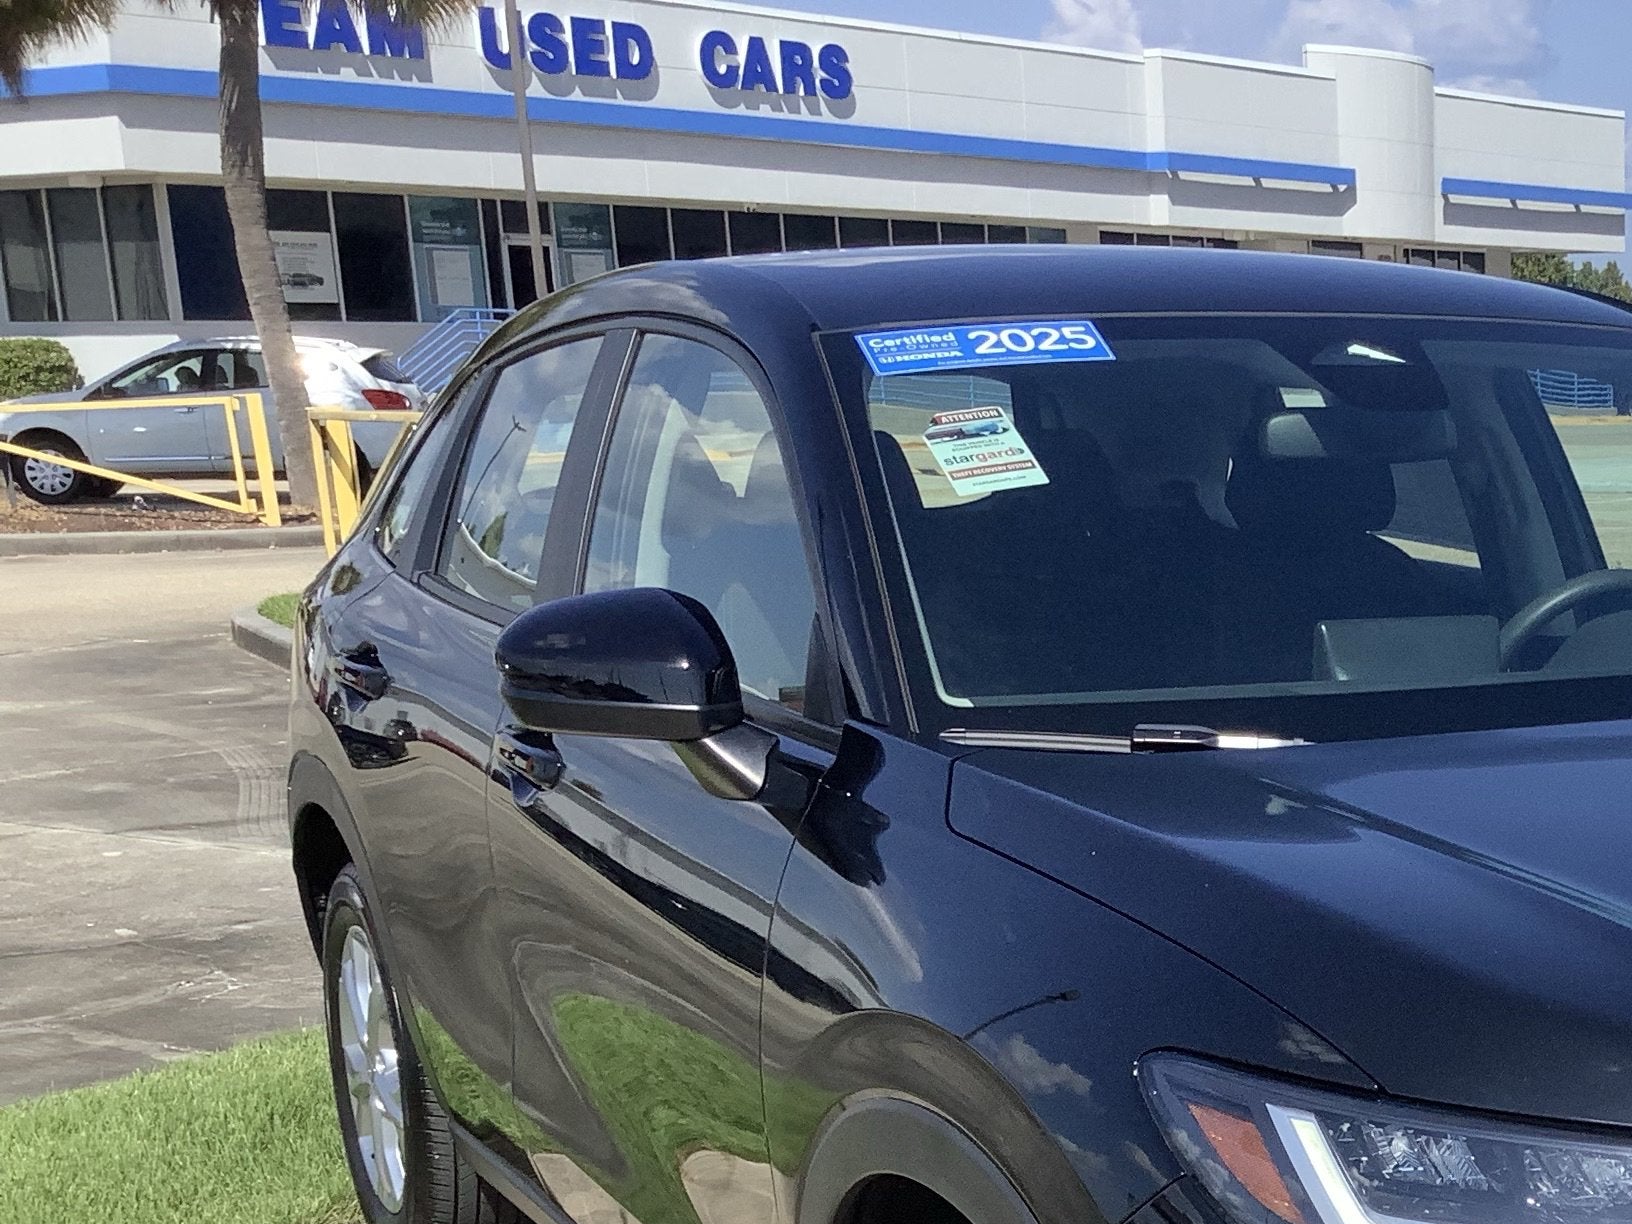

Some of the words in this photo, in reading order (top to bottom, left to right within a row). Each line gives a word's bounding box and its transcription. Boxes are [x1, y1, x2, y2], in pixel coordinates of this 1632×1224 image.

[260, 0, 424, 59] EAM
[477, 6, 653, 81] USED
[699, 29, 853, 100] CARS
[868, 332, 956, 348] Certified
[967, 326, 1097, 354] 2025
[941, 409, 999, 424] ATTENTION
[944, 447, 1015, 466] stargard
